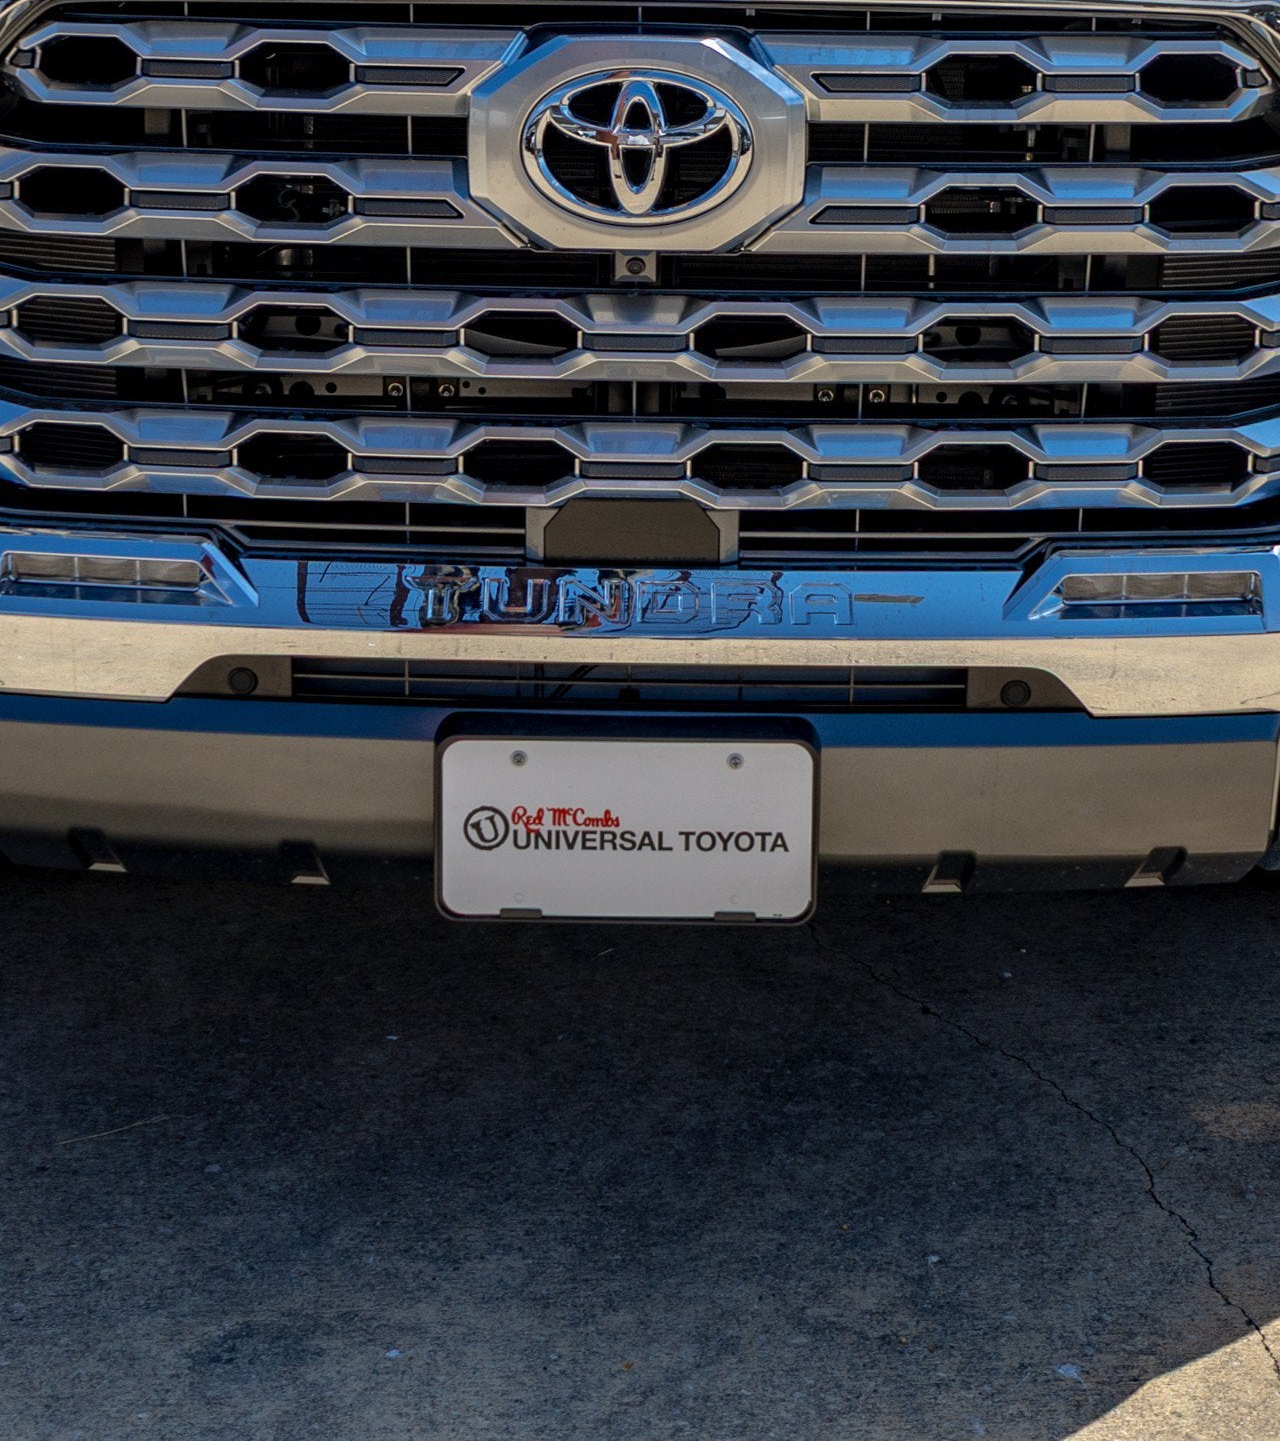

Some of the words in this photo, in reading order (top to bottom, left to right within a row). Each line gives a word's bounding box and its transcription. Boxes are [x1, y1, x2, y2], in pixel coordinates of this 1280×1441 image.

[403, 574, 855, 628] TUNDRA
[511, 805, 545, 833] Red
[547, 806, 620, 828] McCombs
[513, 829, 674, 852] UNIVERSAL
[678, 831, 790, 853] TOYOTA
